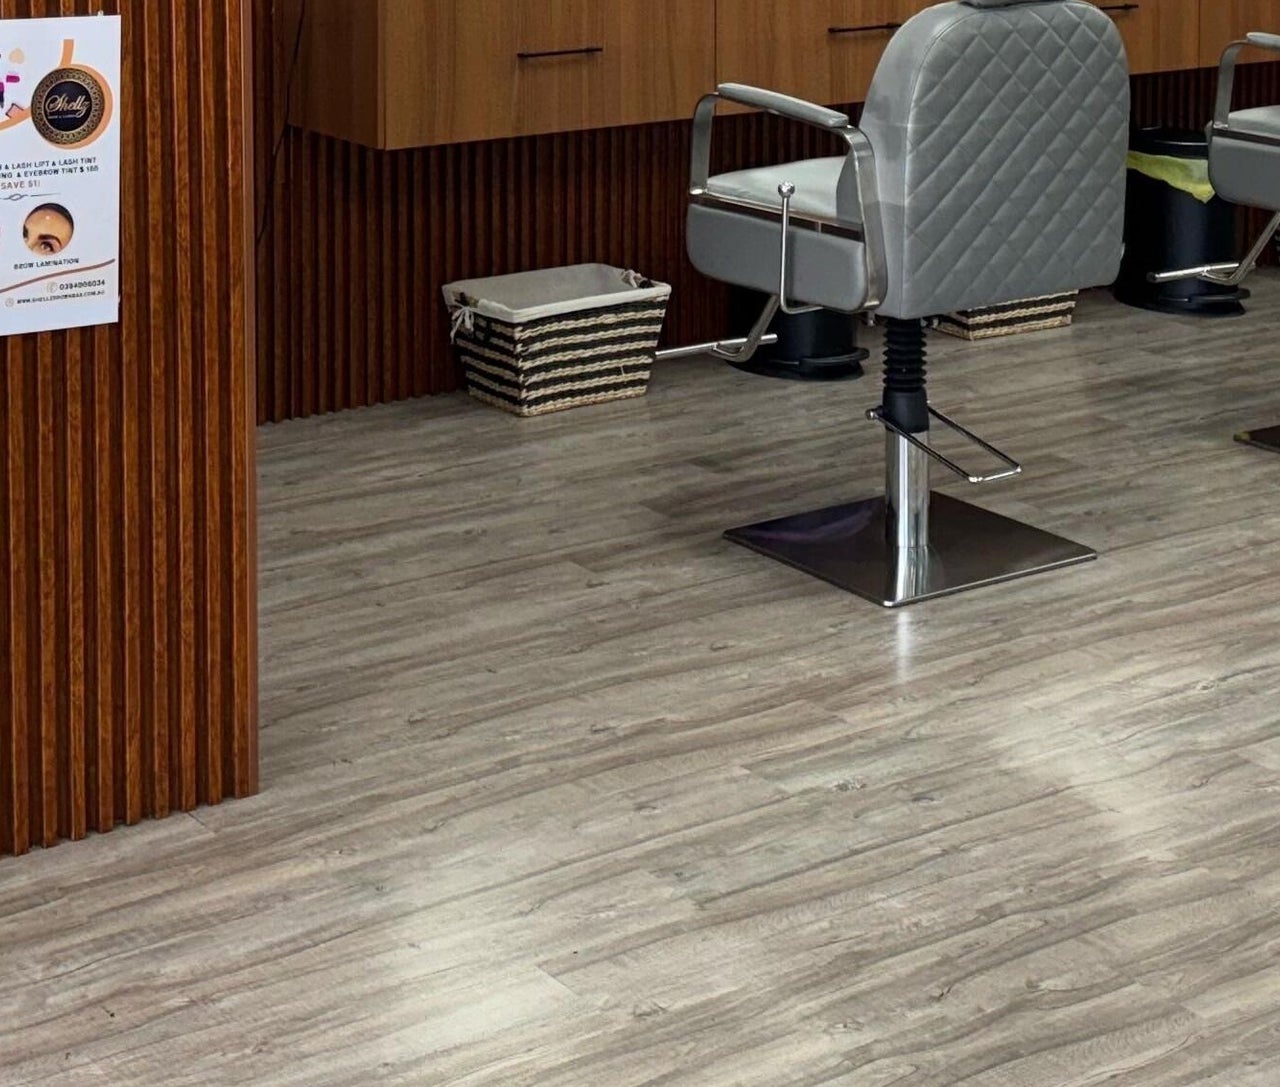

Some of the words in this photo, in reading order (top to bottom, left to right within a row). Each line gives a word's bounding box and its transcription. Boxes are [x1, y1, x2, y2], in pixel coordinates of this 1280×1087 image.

[12, 162, 33, 171] LASH
[35, 160, 50, 168] LIFT
[58, 158, 78, 166] LASH
[24, 168, 59, 178] EYEBROW
[62, 167, 78, 175] TINT
[1, 180, 25, 190] SAVE
[14, 262, 34, 270] BROW
[36, 258, 80, 268] LAMINATION
